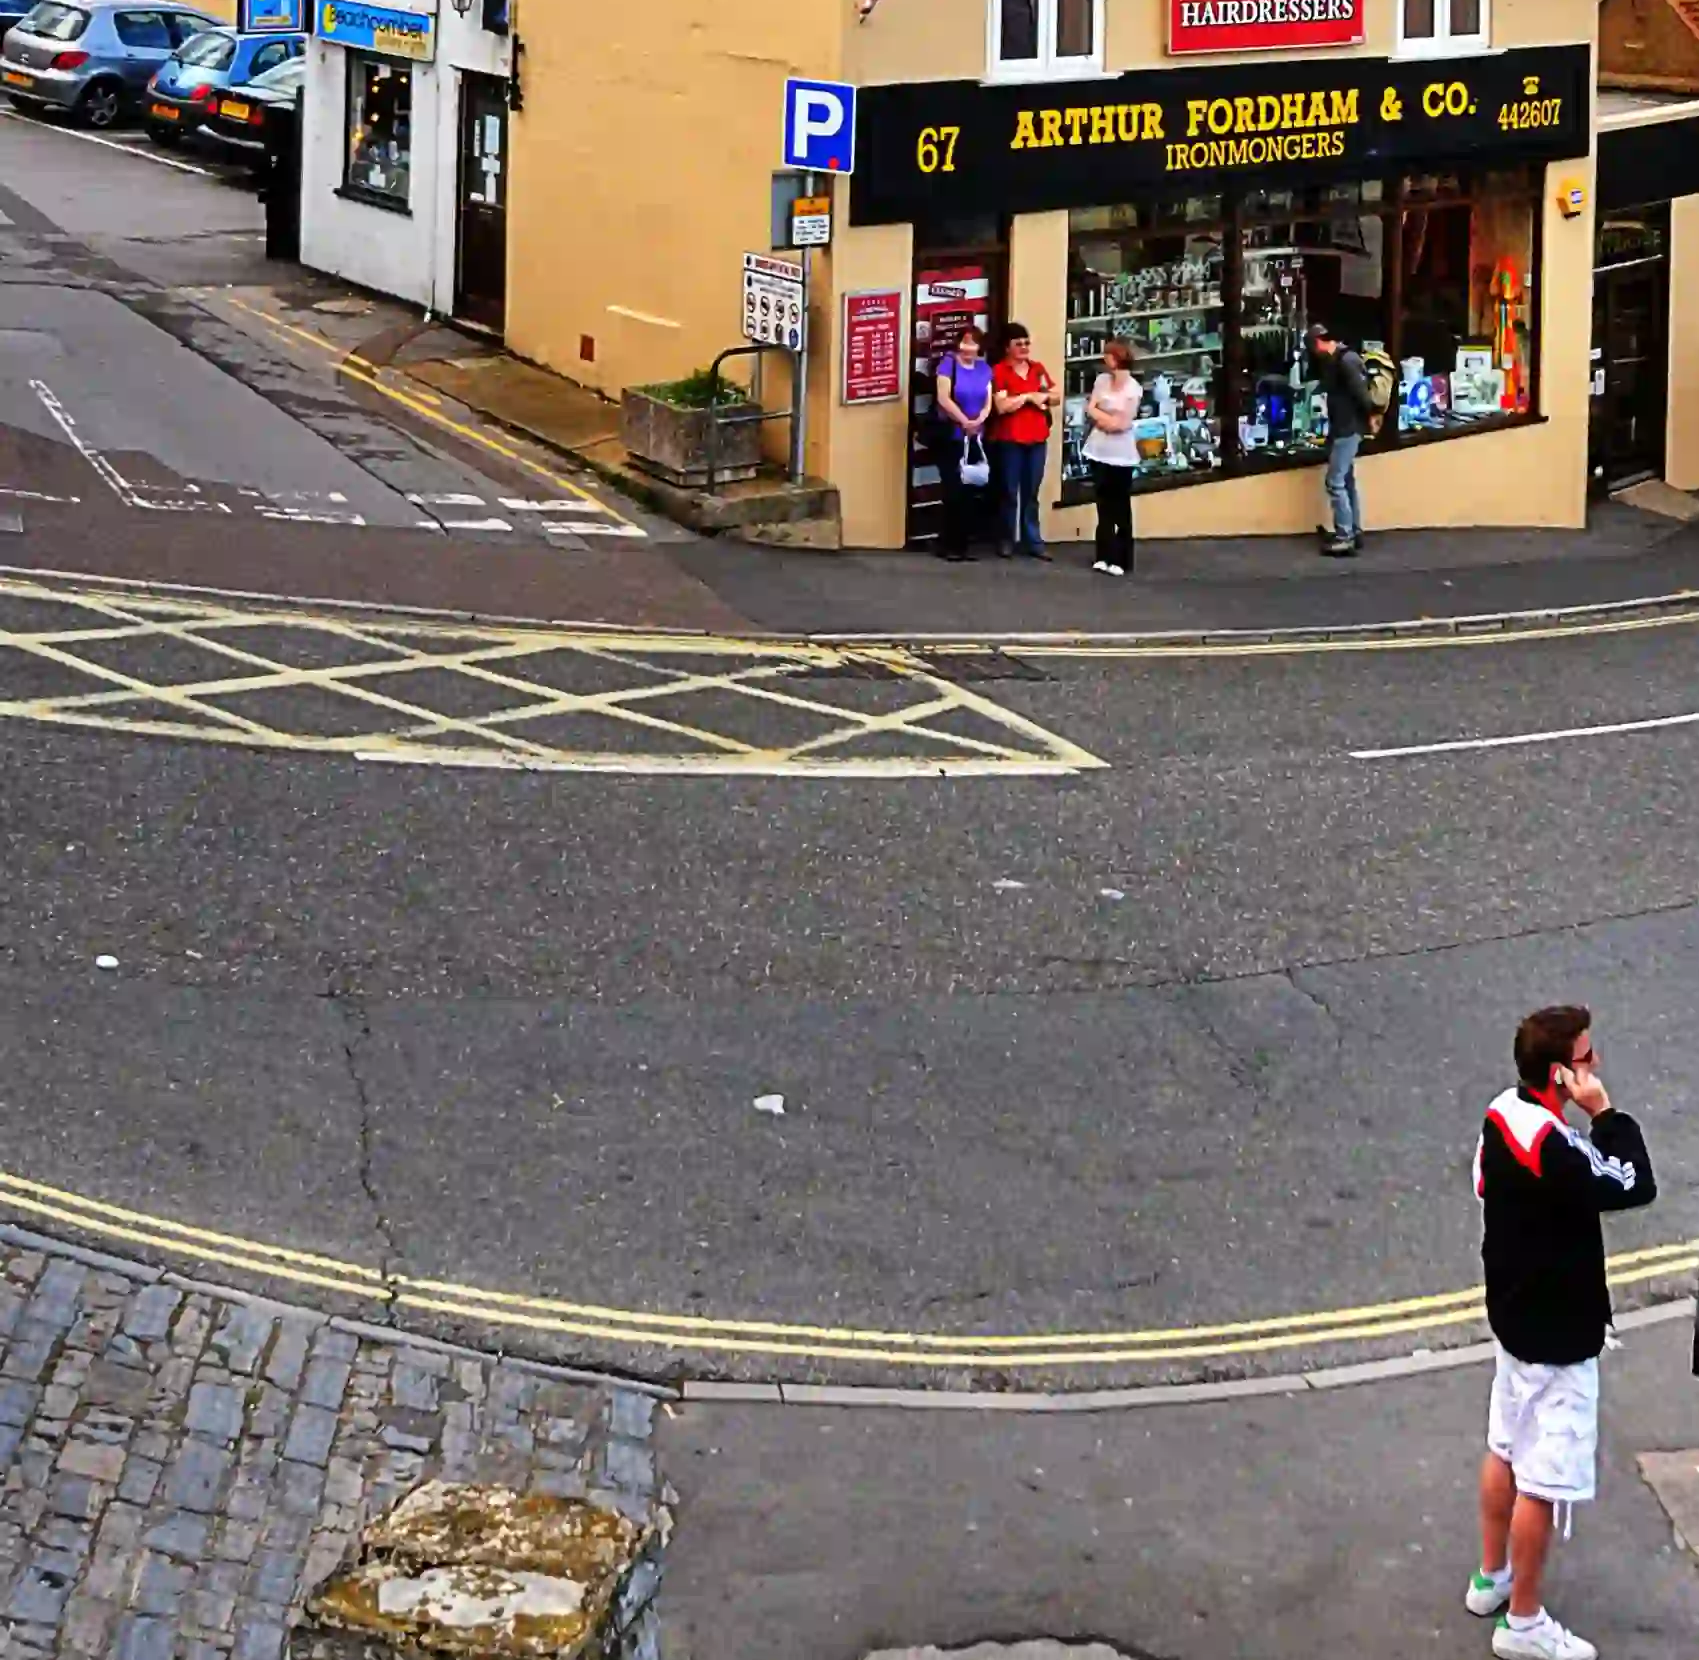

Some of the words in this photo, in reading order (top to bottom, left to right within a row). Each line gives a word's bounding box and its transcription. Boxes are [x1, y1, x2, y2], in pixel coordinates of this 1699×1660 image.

[794, 89, 844, 159] P
[917, 126, 960, 173] 67
[1010, 103, 1164, 149] ARTHUR
[1186, 88, 1359, 137] FORDHAM
[1380, 86, 1404, 122] &
[1423, 81, 1476, 117] CO.
[1498, 98, 1562, 131] 442607
[1166, 131, 1345, 171] IRONMONGERS
